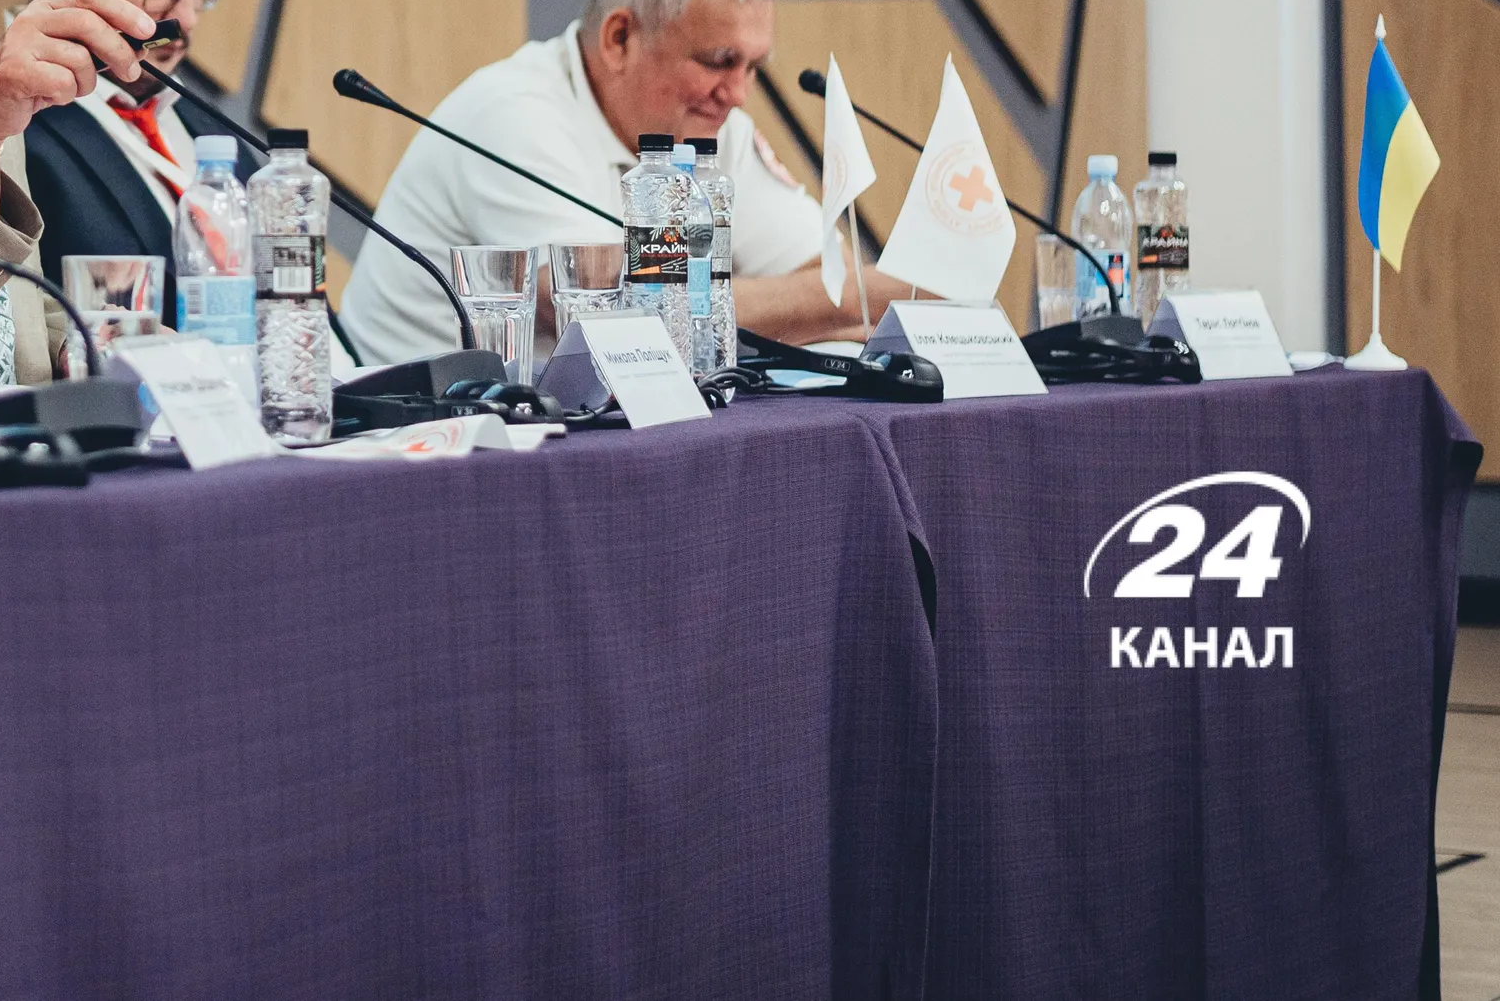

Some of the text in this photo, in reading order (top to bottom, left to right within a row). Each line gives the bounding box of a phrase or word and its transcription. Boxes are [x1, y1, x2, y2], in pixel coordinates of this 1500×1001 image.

[640, 242, 688, 254] КРАЙН
[603, 346, 673, 364] Микола Поліщук
